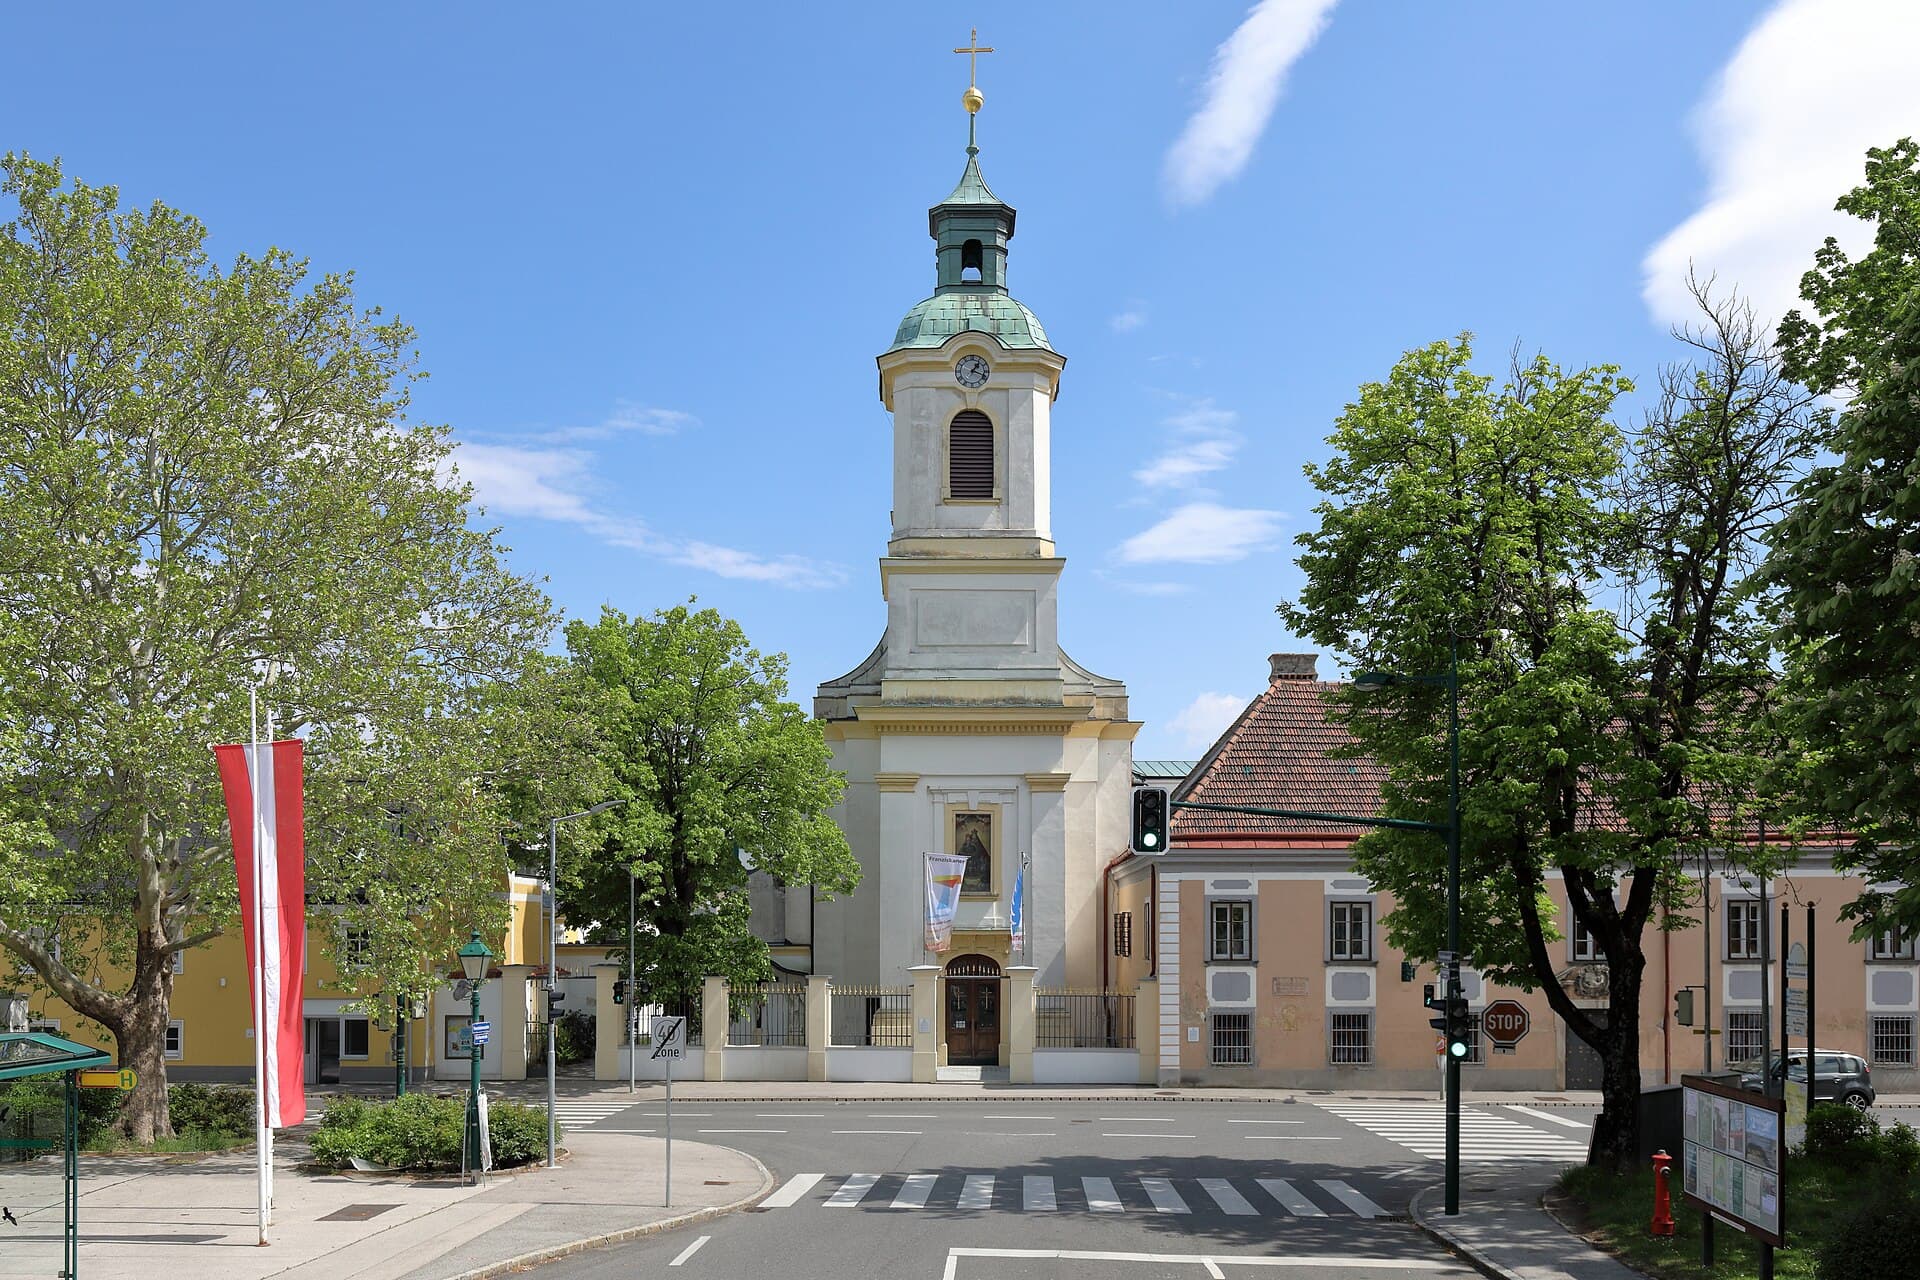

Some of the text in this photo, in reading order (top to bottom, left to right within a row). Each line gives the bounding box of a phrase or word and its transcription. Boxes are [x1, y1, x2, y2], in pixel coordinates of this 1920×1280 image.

[1488, 1014, 1523, 1030] STOP
[658, 1025, 675, 1041] 40
[655, 1046, 680, 1058] Zone
[121, 1072, 133, 1087] H
